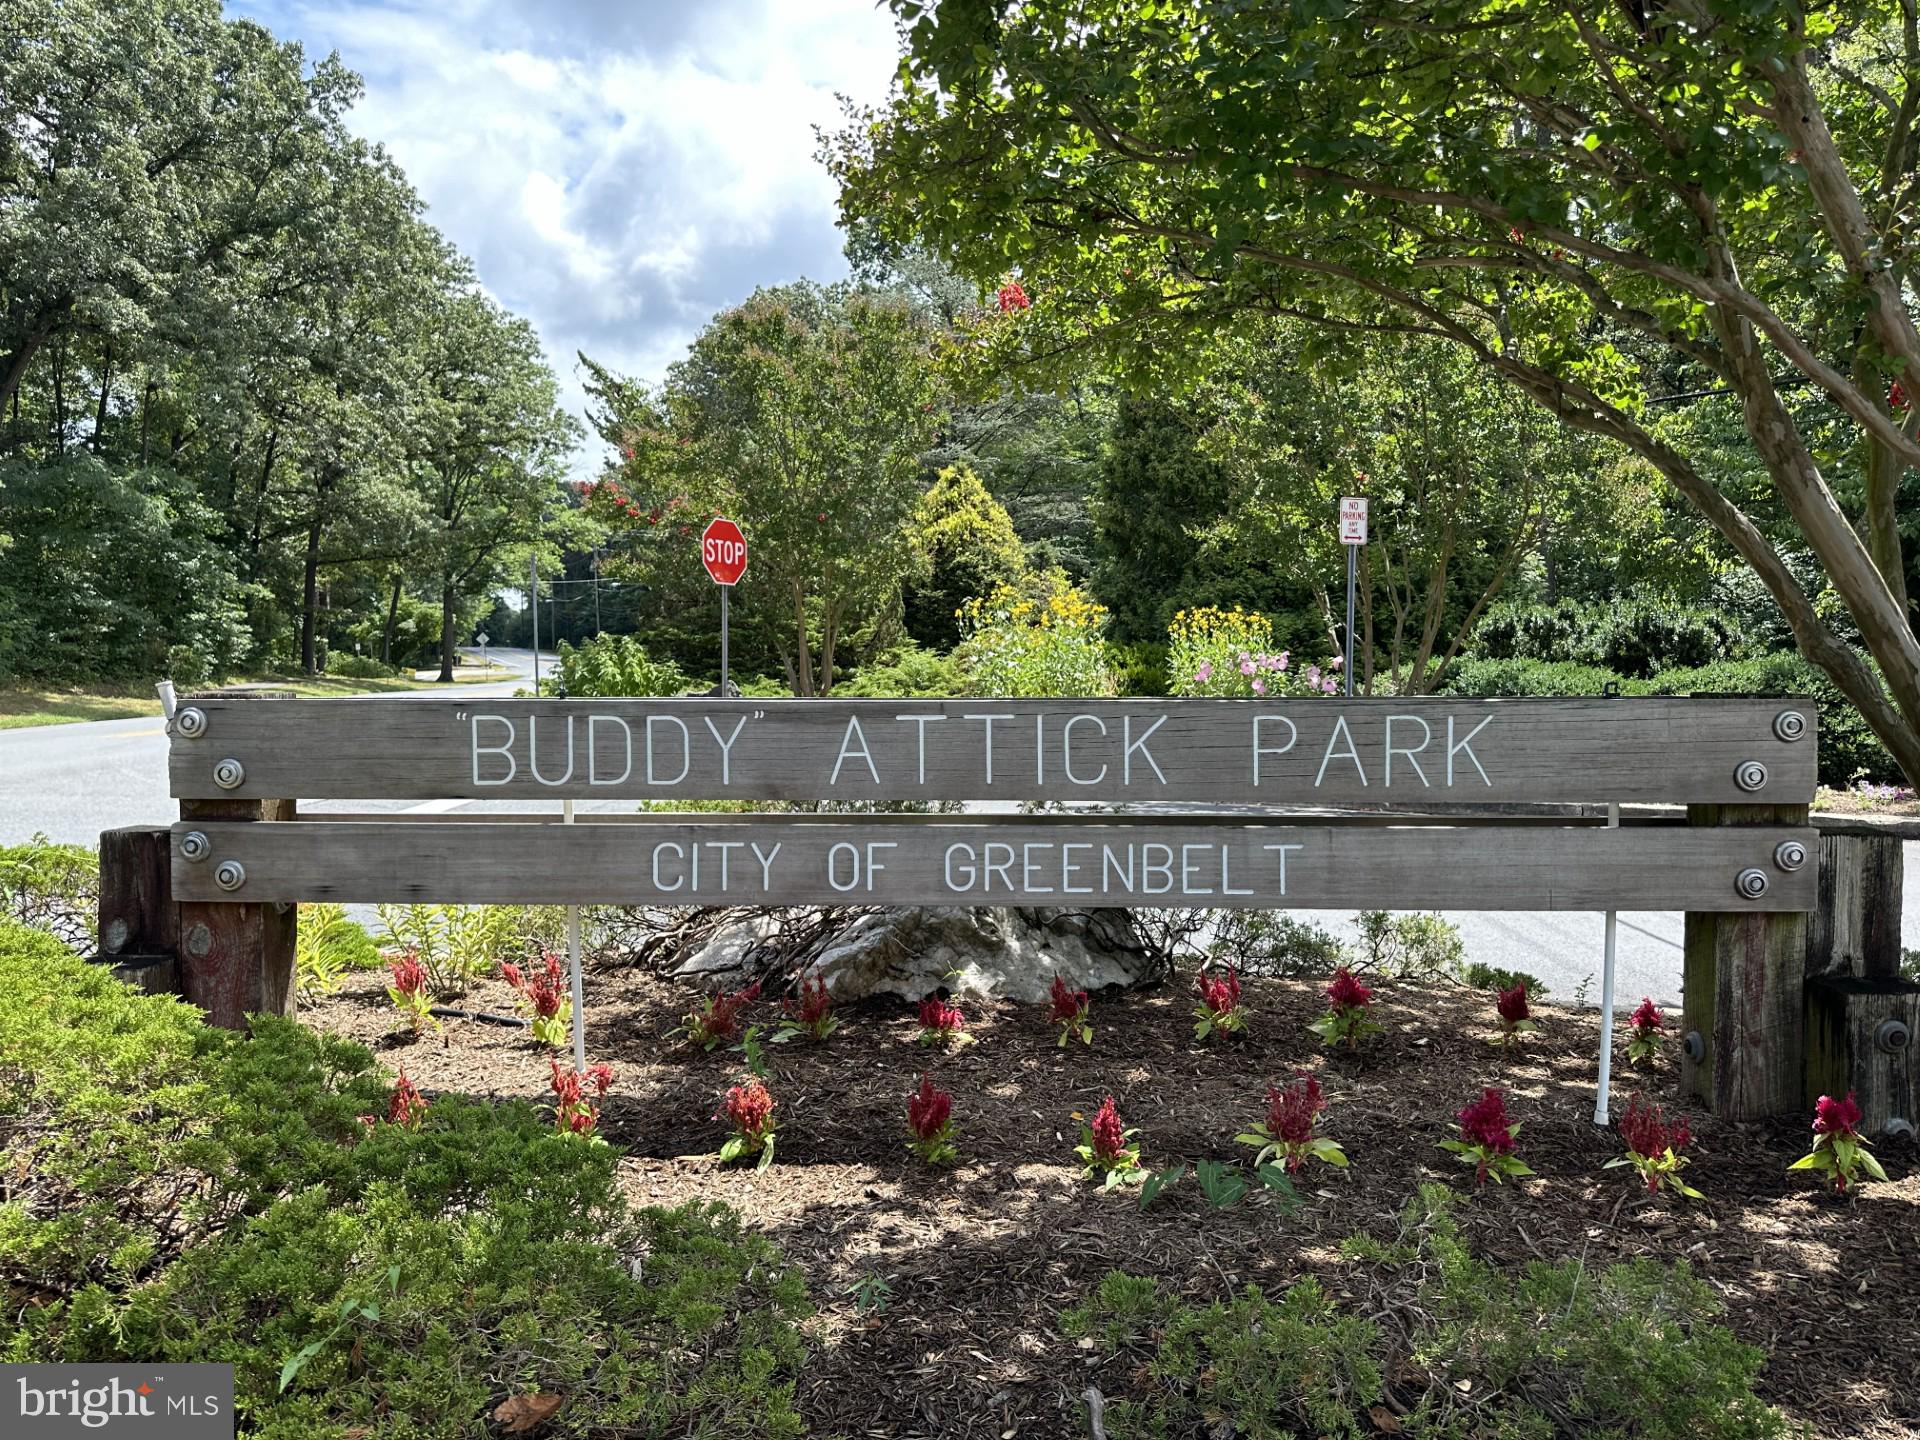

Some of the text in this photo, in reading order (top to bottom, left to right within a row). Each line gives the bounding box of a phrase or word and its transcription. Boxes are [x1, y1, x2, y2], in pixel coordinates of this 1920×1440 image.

[1342, 511, 1365, 520] PARKING
[1348, 502, 1358, 510] NO
[706, 538, 744, 565] STOP
[829, 714, 1169, 786] ATTICK
[1252, 714, 1495, 788] PARK
[652, 842, 1305, 896] CITY OF GREENBELT
